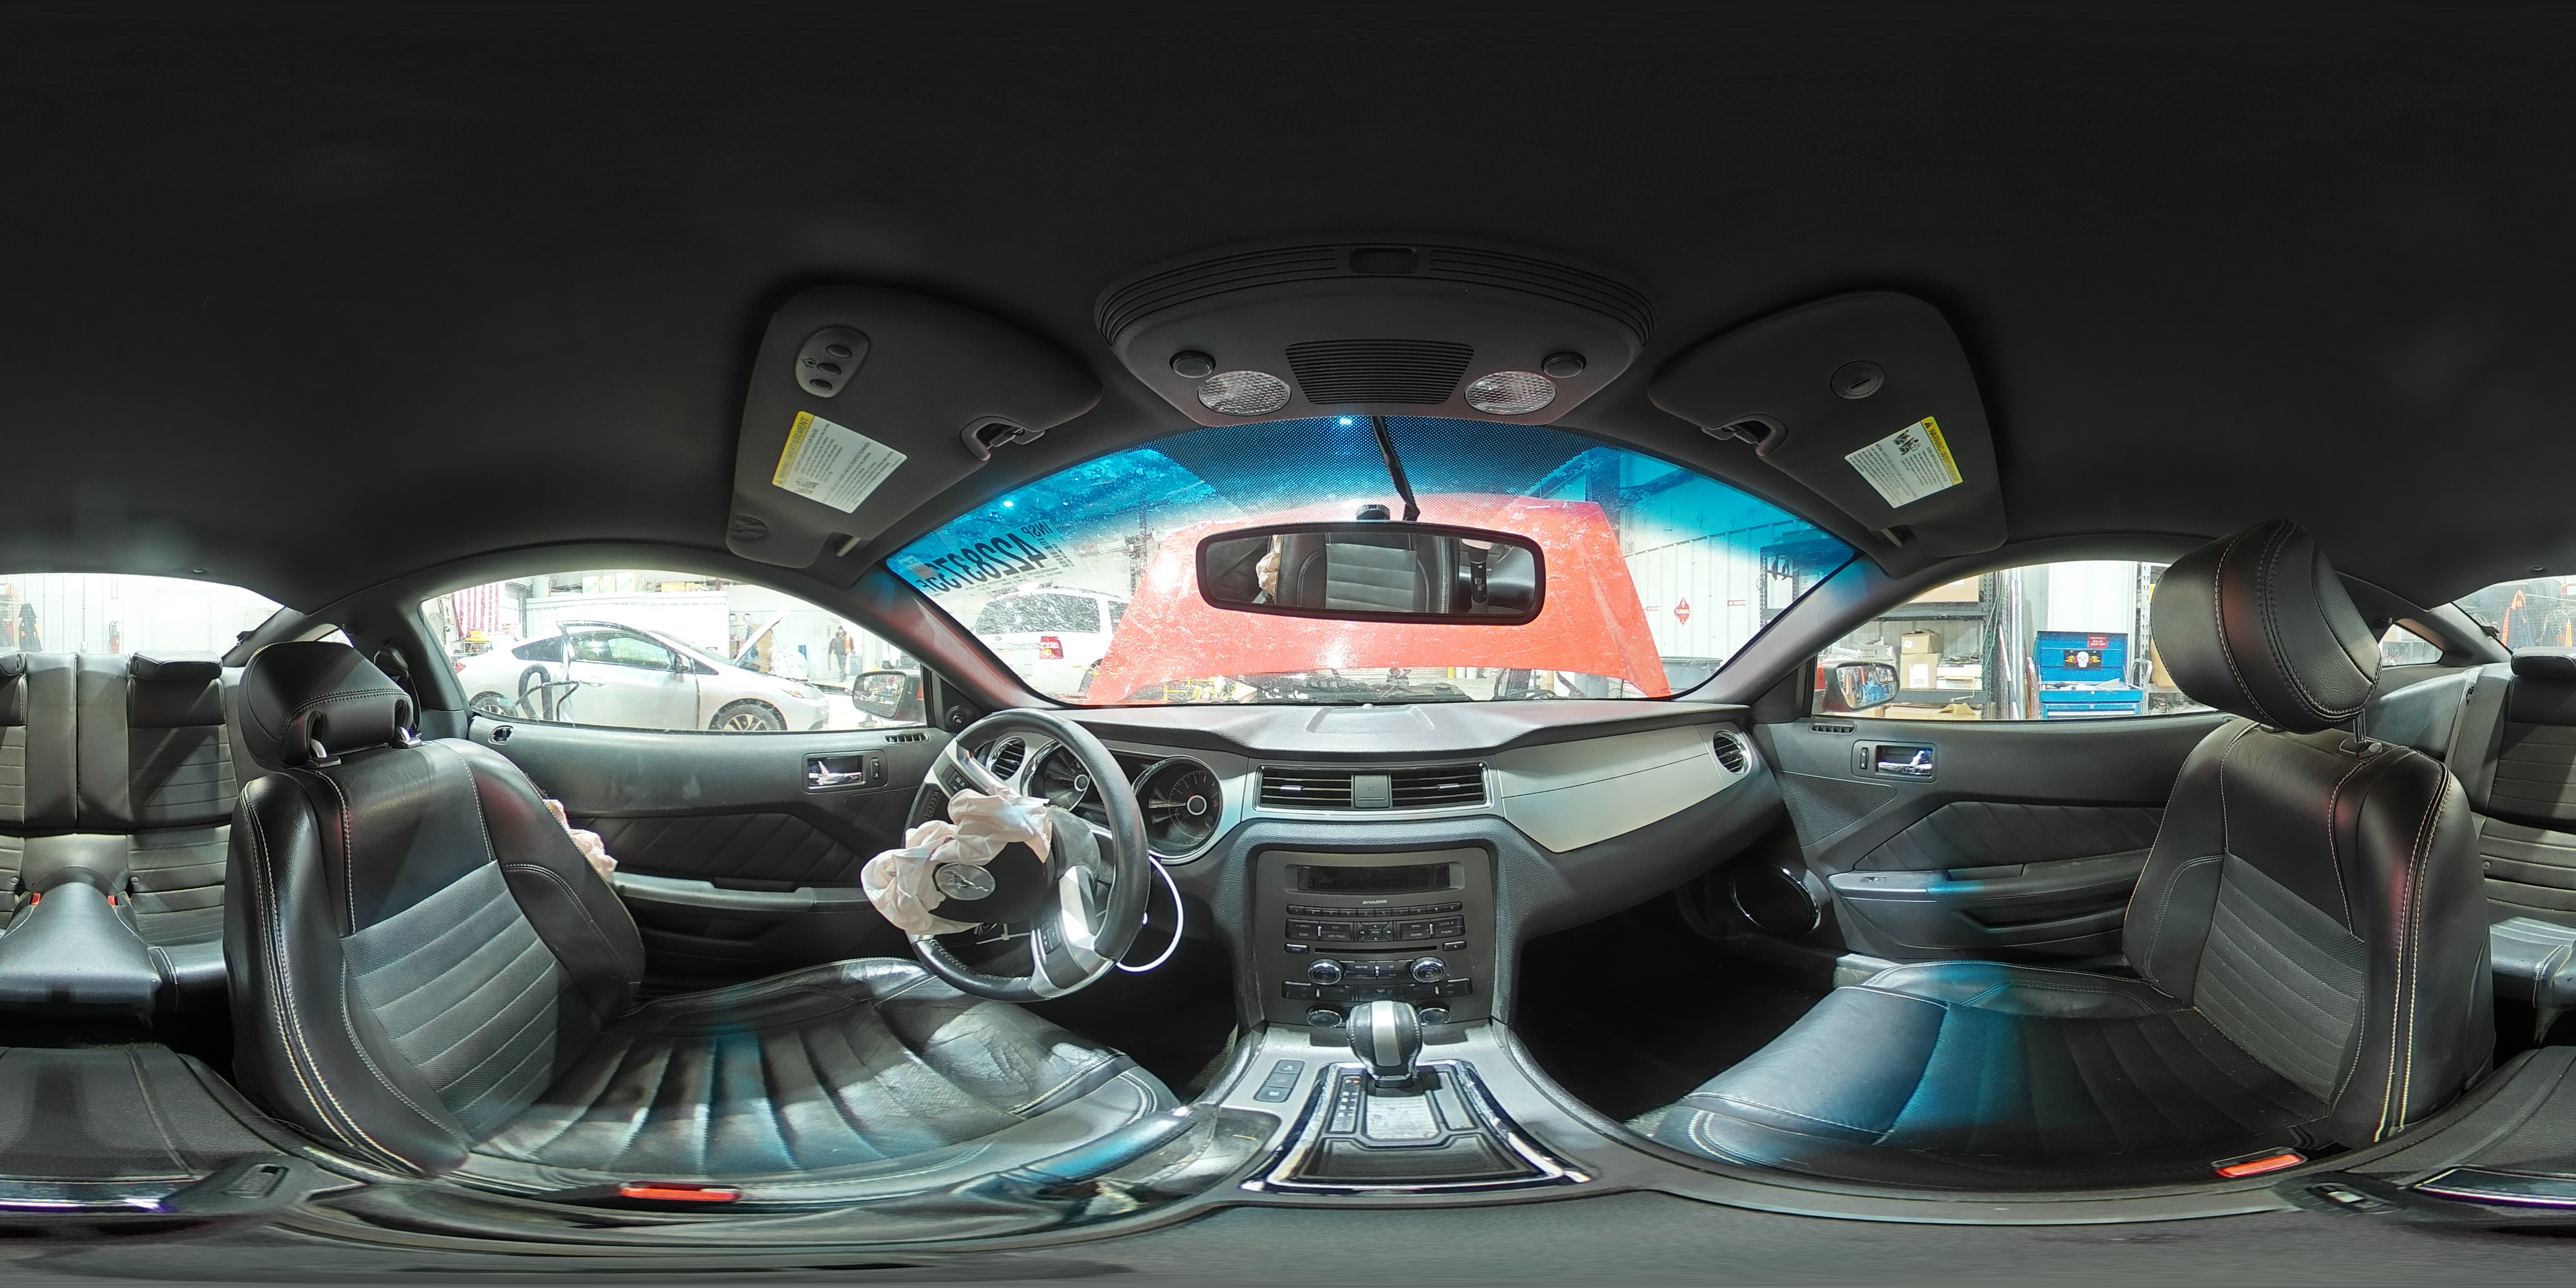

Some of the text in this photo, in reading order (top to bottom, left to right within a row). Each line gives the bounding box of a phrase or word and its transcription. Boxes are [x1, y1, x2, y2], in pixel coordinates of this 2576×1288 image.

[787, 416, 810, 460] AVERTISSEMENT
[1928, 427, 1944, 451] WARNING
[1939, 451, 1959, 482] AVERTISSEMENT
